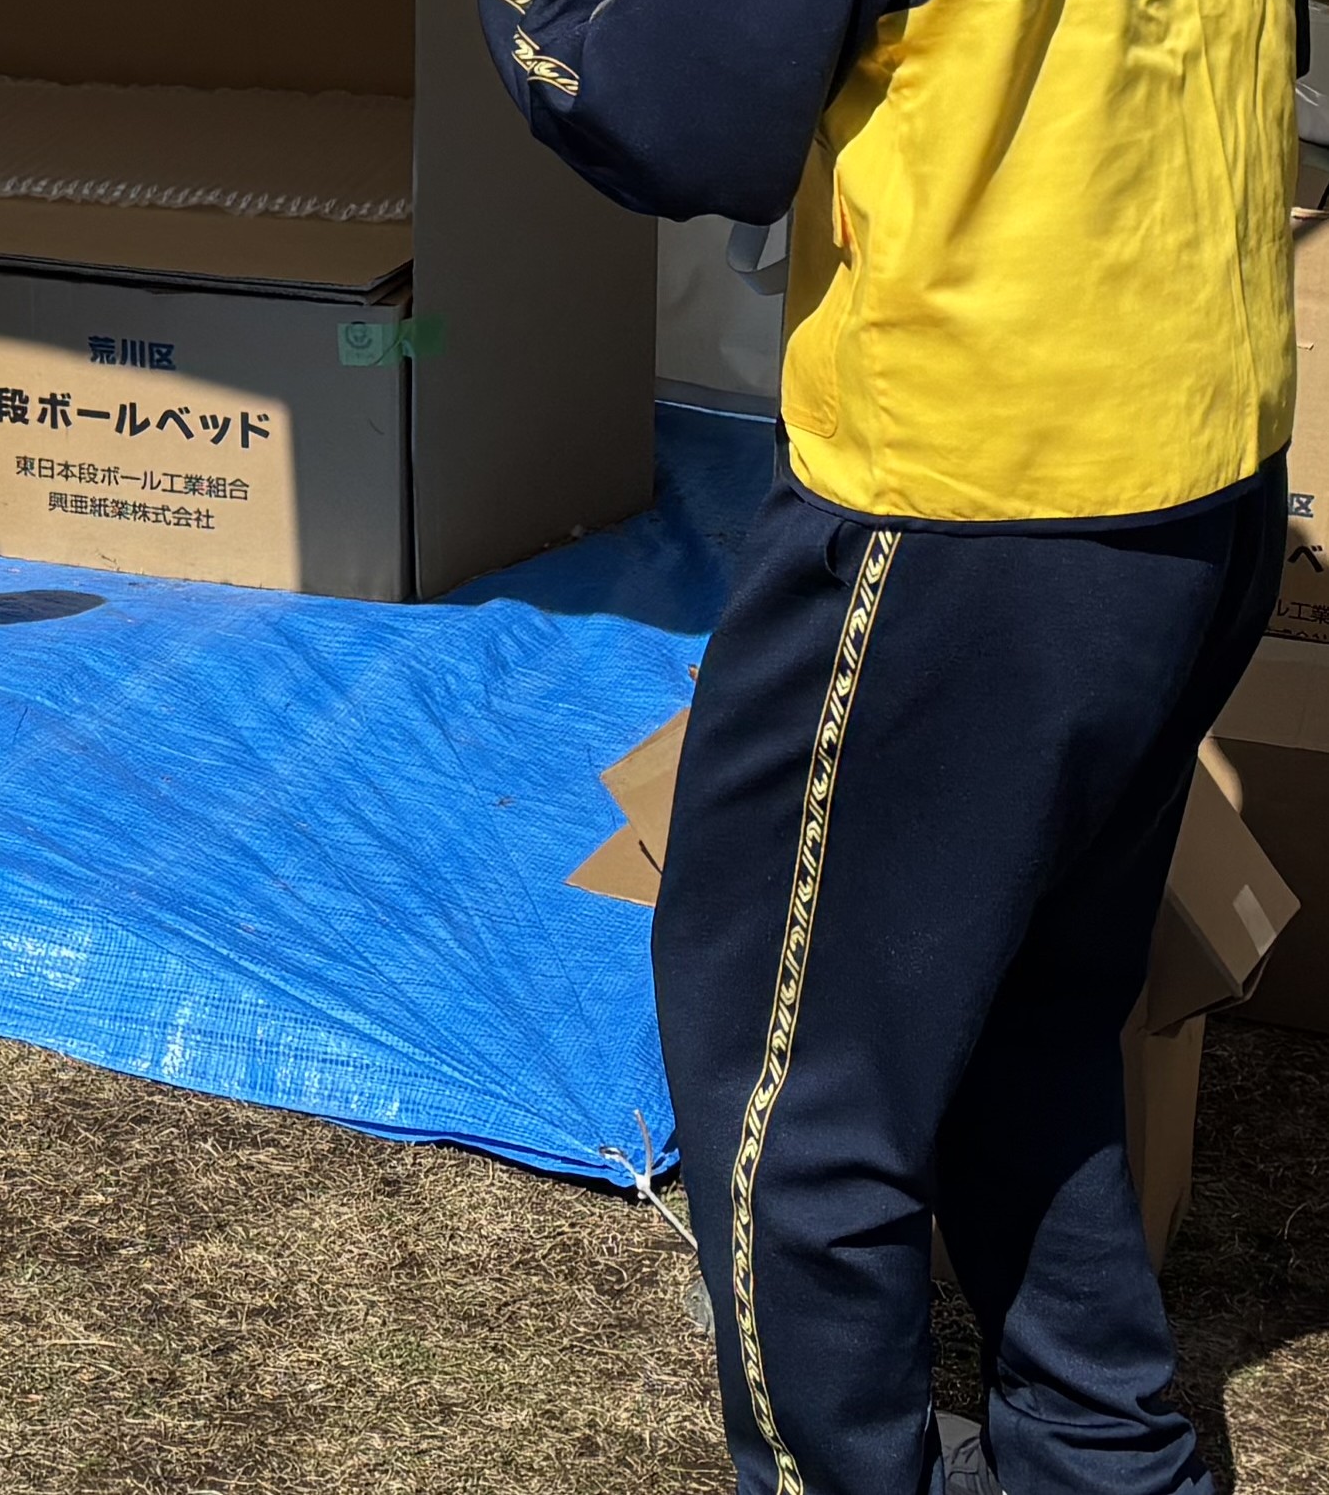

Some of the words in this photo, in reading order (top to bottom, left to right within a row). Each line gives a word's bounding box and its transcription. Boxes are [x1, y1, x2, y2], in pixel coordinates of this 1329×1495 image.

[88, 335, 176, 371] 荒川区
[15, 456, 250, 501] 東日本段ボール工業組合
[48, 492, 216, 530] 興亜紙業株式会社
